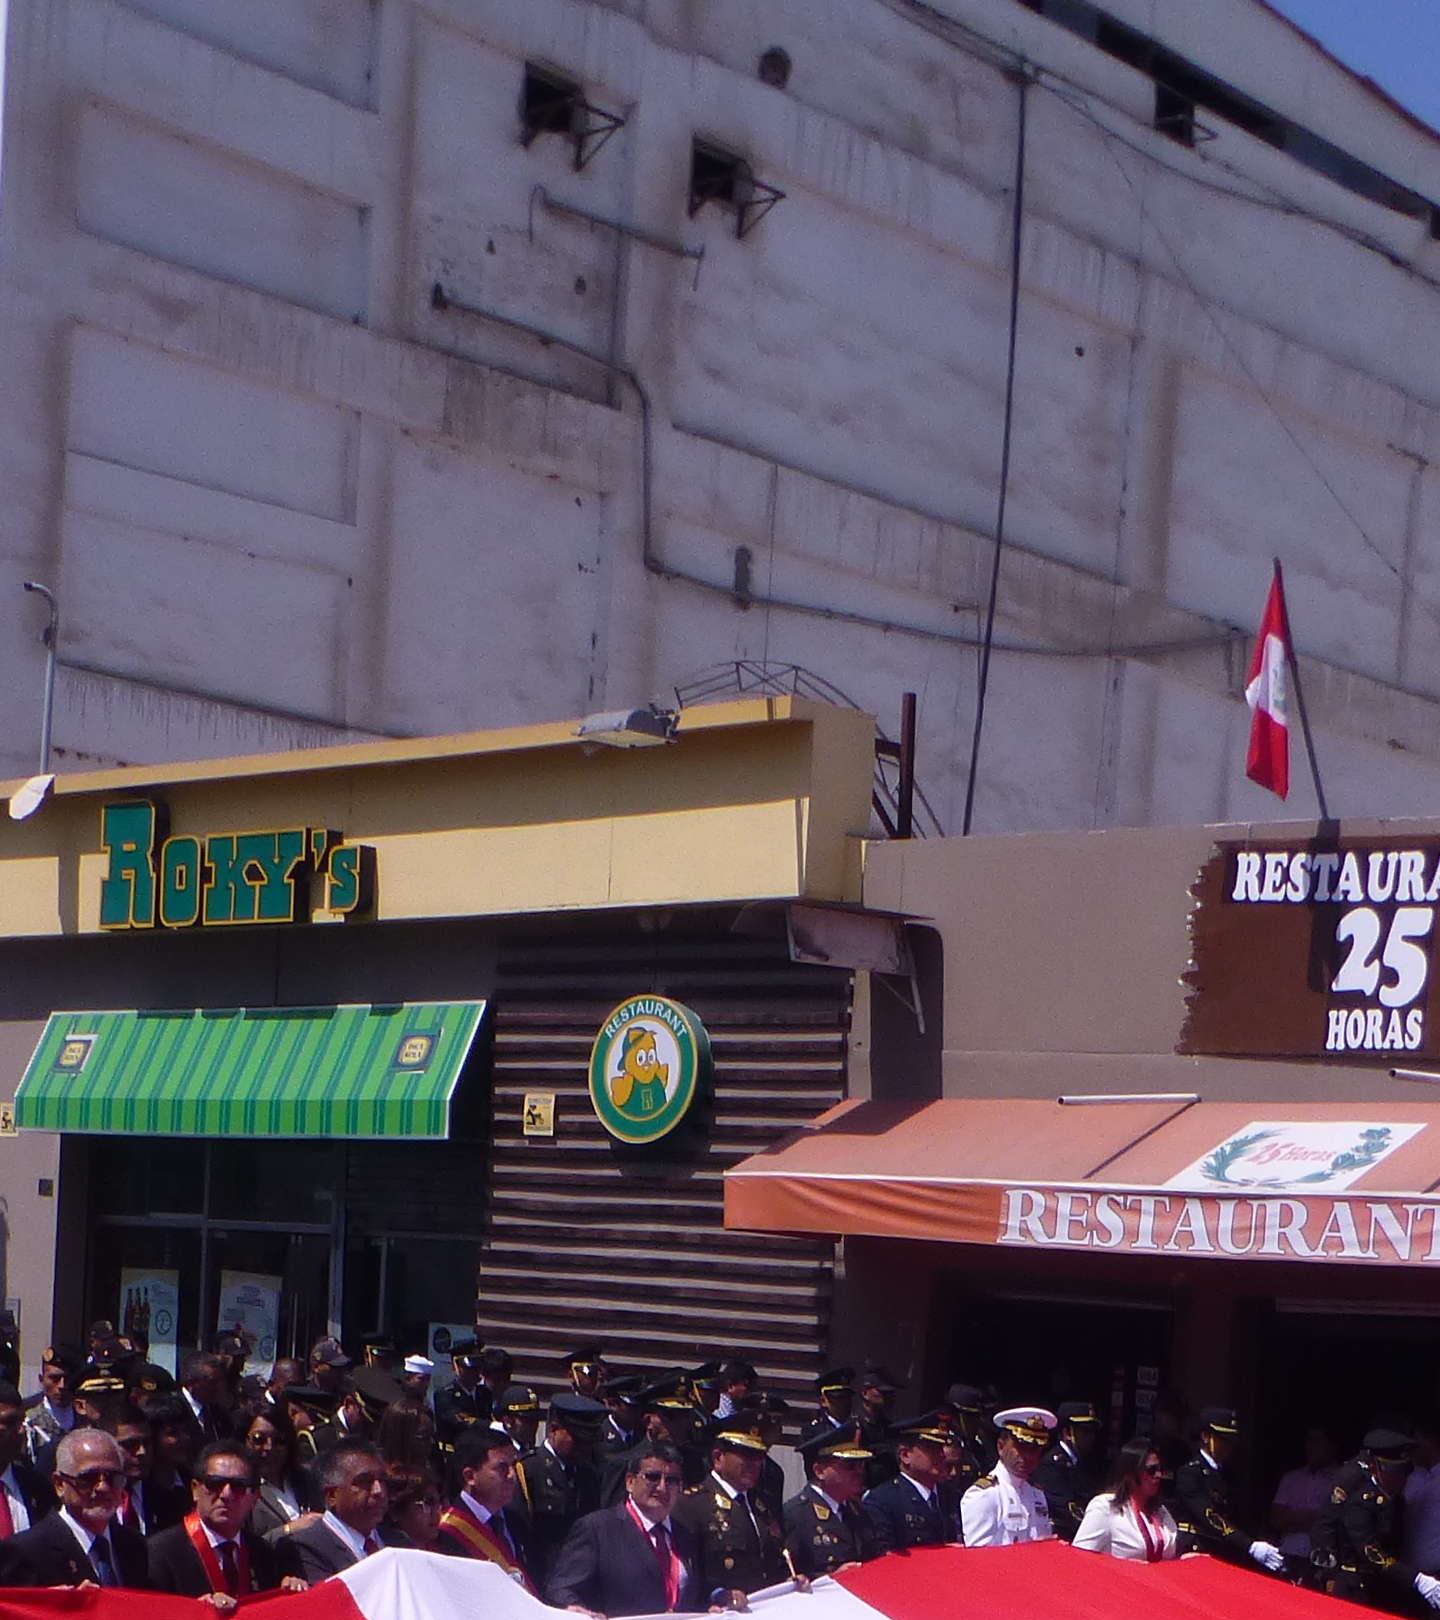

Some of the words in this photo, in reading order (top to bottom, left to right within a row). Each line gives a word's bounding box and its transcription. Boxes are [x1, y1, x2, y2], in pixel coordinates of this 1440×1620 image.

[1331, 907, 1434, 1008] 25
[604, 1000, 688, 1039] RESTAURANT
[1325, 1009, 1424, 1050] HORAS
[1278, 1146, 1336, 1162] Horas
